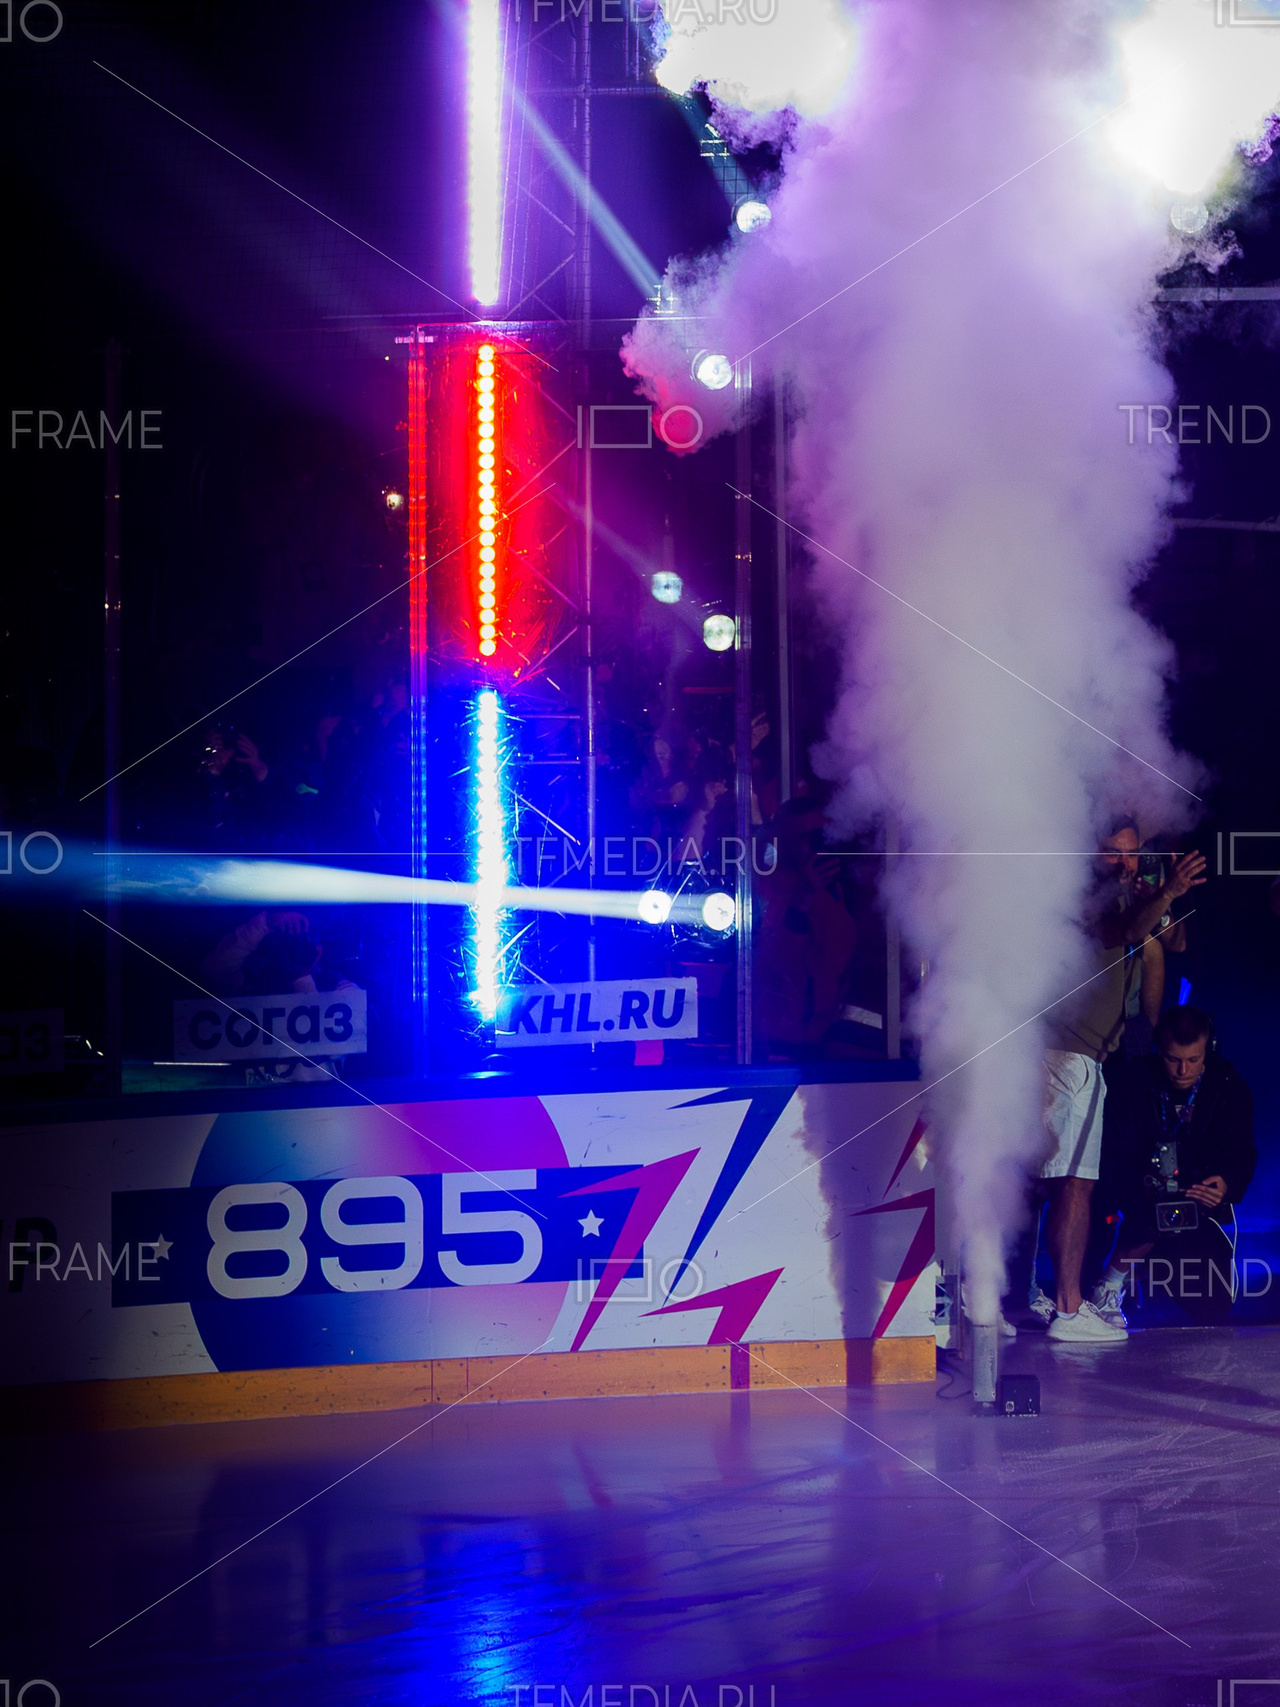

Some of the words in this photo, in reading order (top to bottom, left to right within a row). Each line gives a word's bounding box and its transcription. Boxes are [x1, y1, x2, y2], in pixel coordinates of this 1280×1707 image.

[188, 1002, 354, 1050] согаз
[508, 988, 687, 1035] KHL.RU
[206, 1168, 543, 1300] 895
